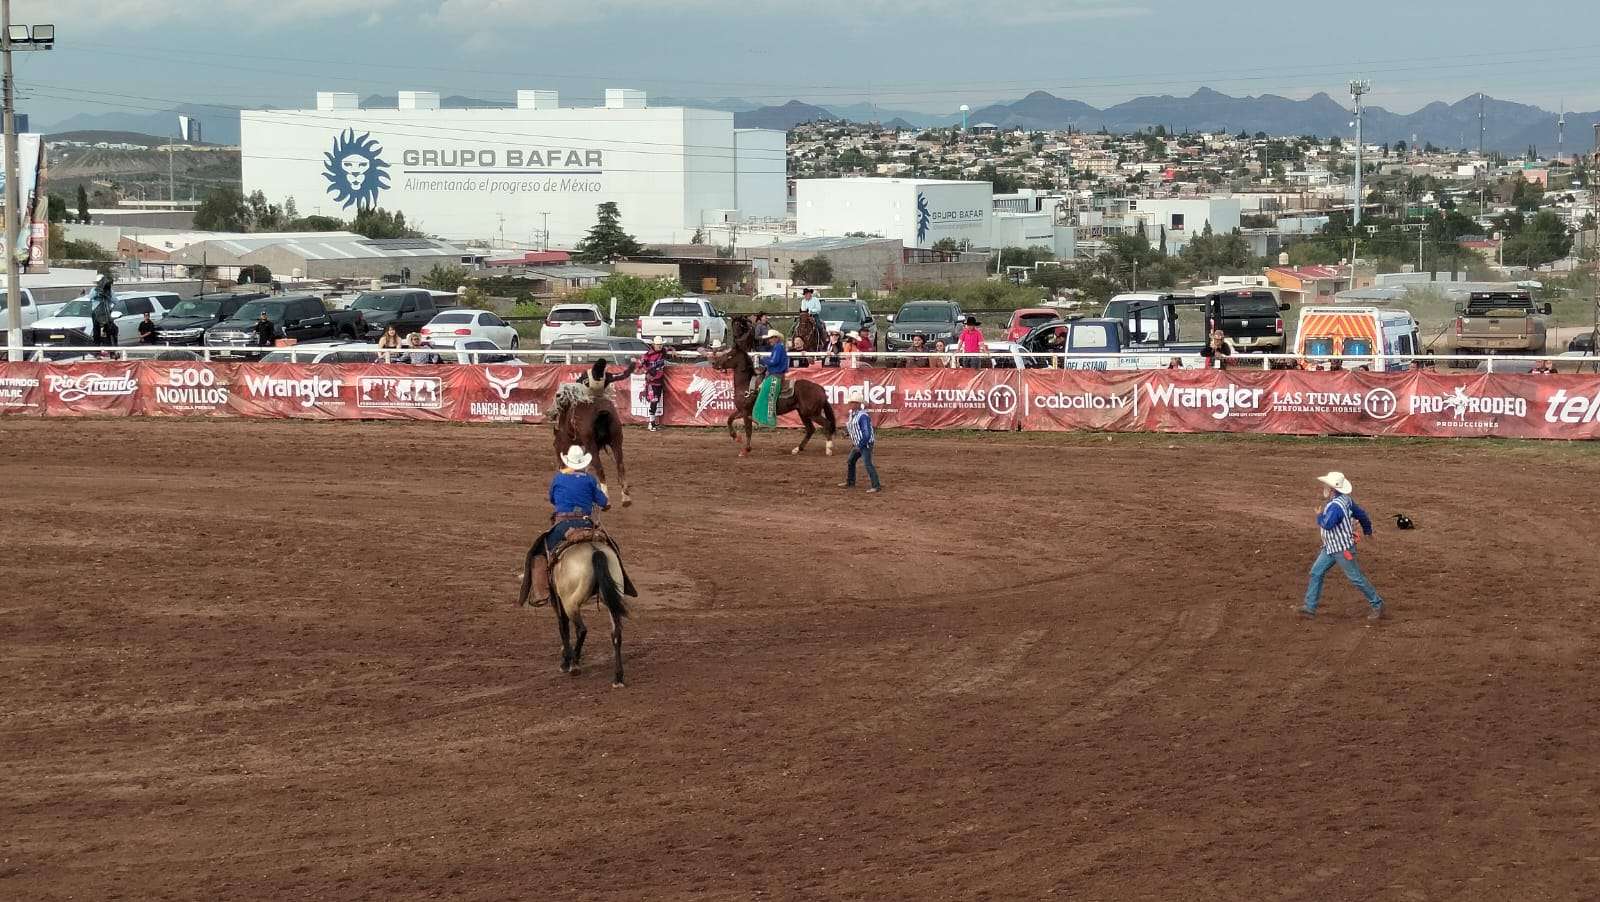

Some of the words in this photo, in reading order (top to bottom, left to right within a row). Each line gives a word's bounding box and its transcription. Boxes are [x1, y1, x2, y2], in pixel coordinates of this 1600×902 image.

[403, 150, 496, 167] GRUPO
[506, 150, 602, 167] BAFAR
[404, 178, 476, 192] Alimentando
[479, 179, 489, 192] el
[490, 180, 541, 195] progreso
[543, 179, 557, 192] de
[560, 179, 602, 192] México
[932, 211, 957, 220] GRUPO
[960, 210, 983, 219] BAFAR
[60, 369, 139, 401] Grande
[168, 367, 215, 387] 500
[156, 386, 229, 404] NOVILLOS
[244, 374, 343, 407] Wrangler
[905, 389, 931, 401] LAS
[934, 389, 986, 402] TUNAS
[1272, 391, 1303, 405] LAS
[1305, 392, 1362, 406] TUNAS
[470, 402, 498, 415] RANCH
[500, 402, 507, 415] &
[508, 403, 540, 416] CORRAL
[710, 401, 738, 410] CHIH
[1034, 392, 1128, 409] caballo.tv
[1145, 382, 1263, 419] Wrangler
[1409, 395, 1443, 416] PRO
[1468, 397, 1527, 418] RODEO
[1544, 389, 1600, 423] tel
